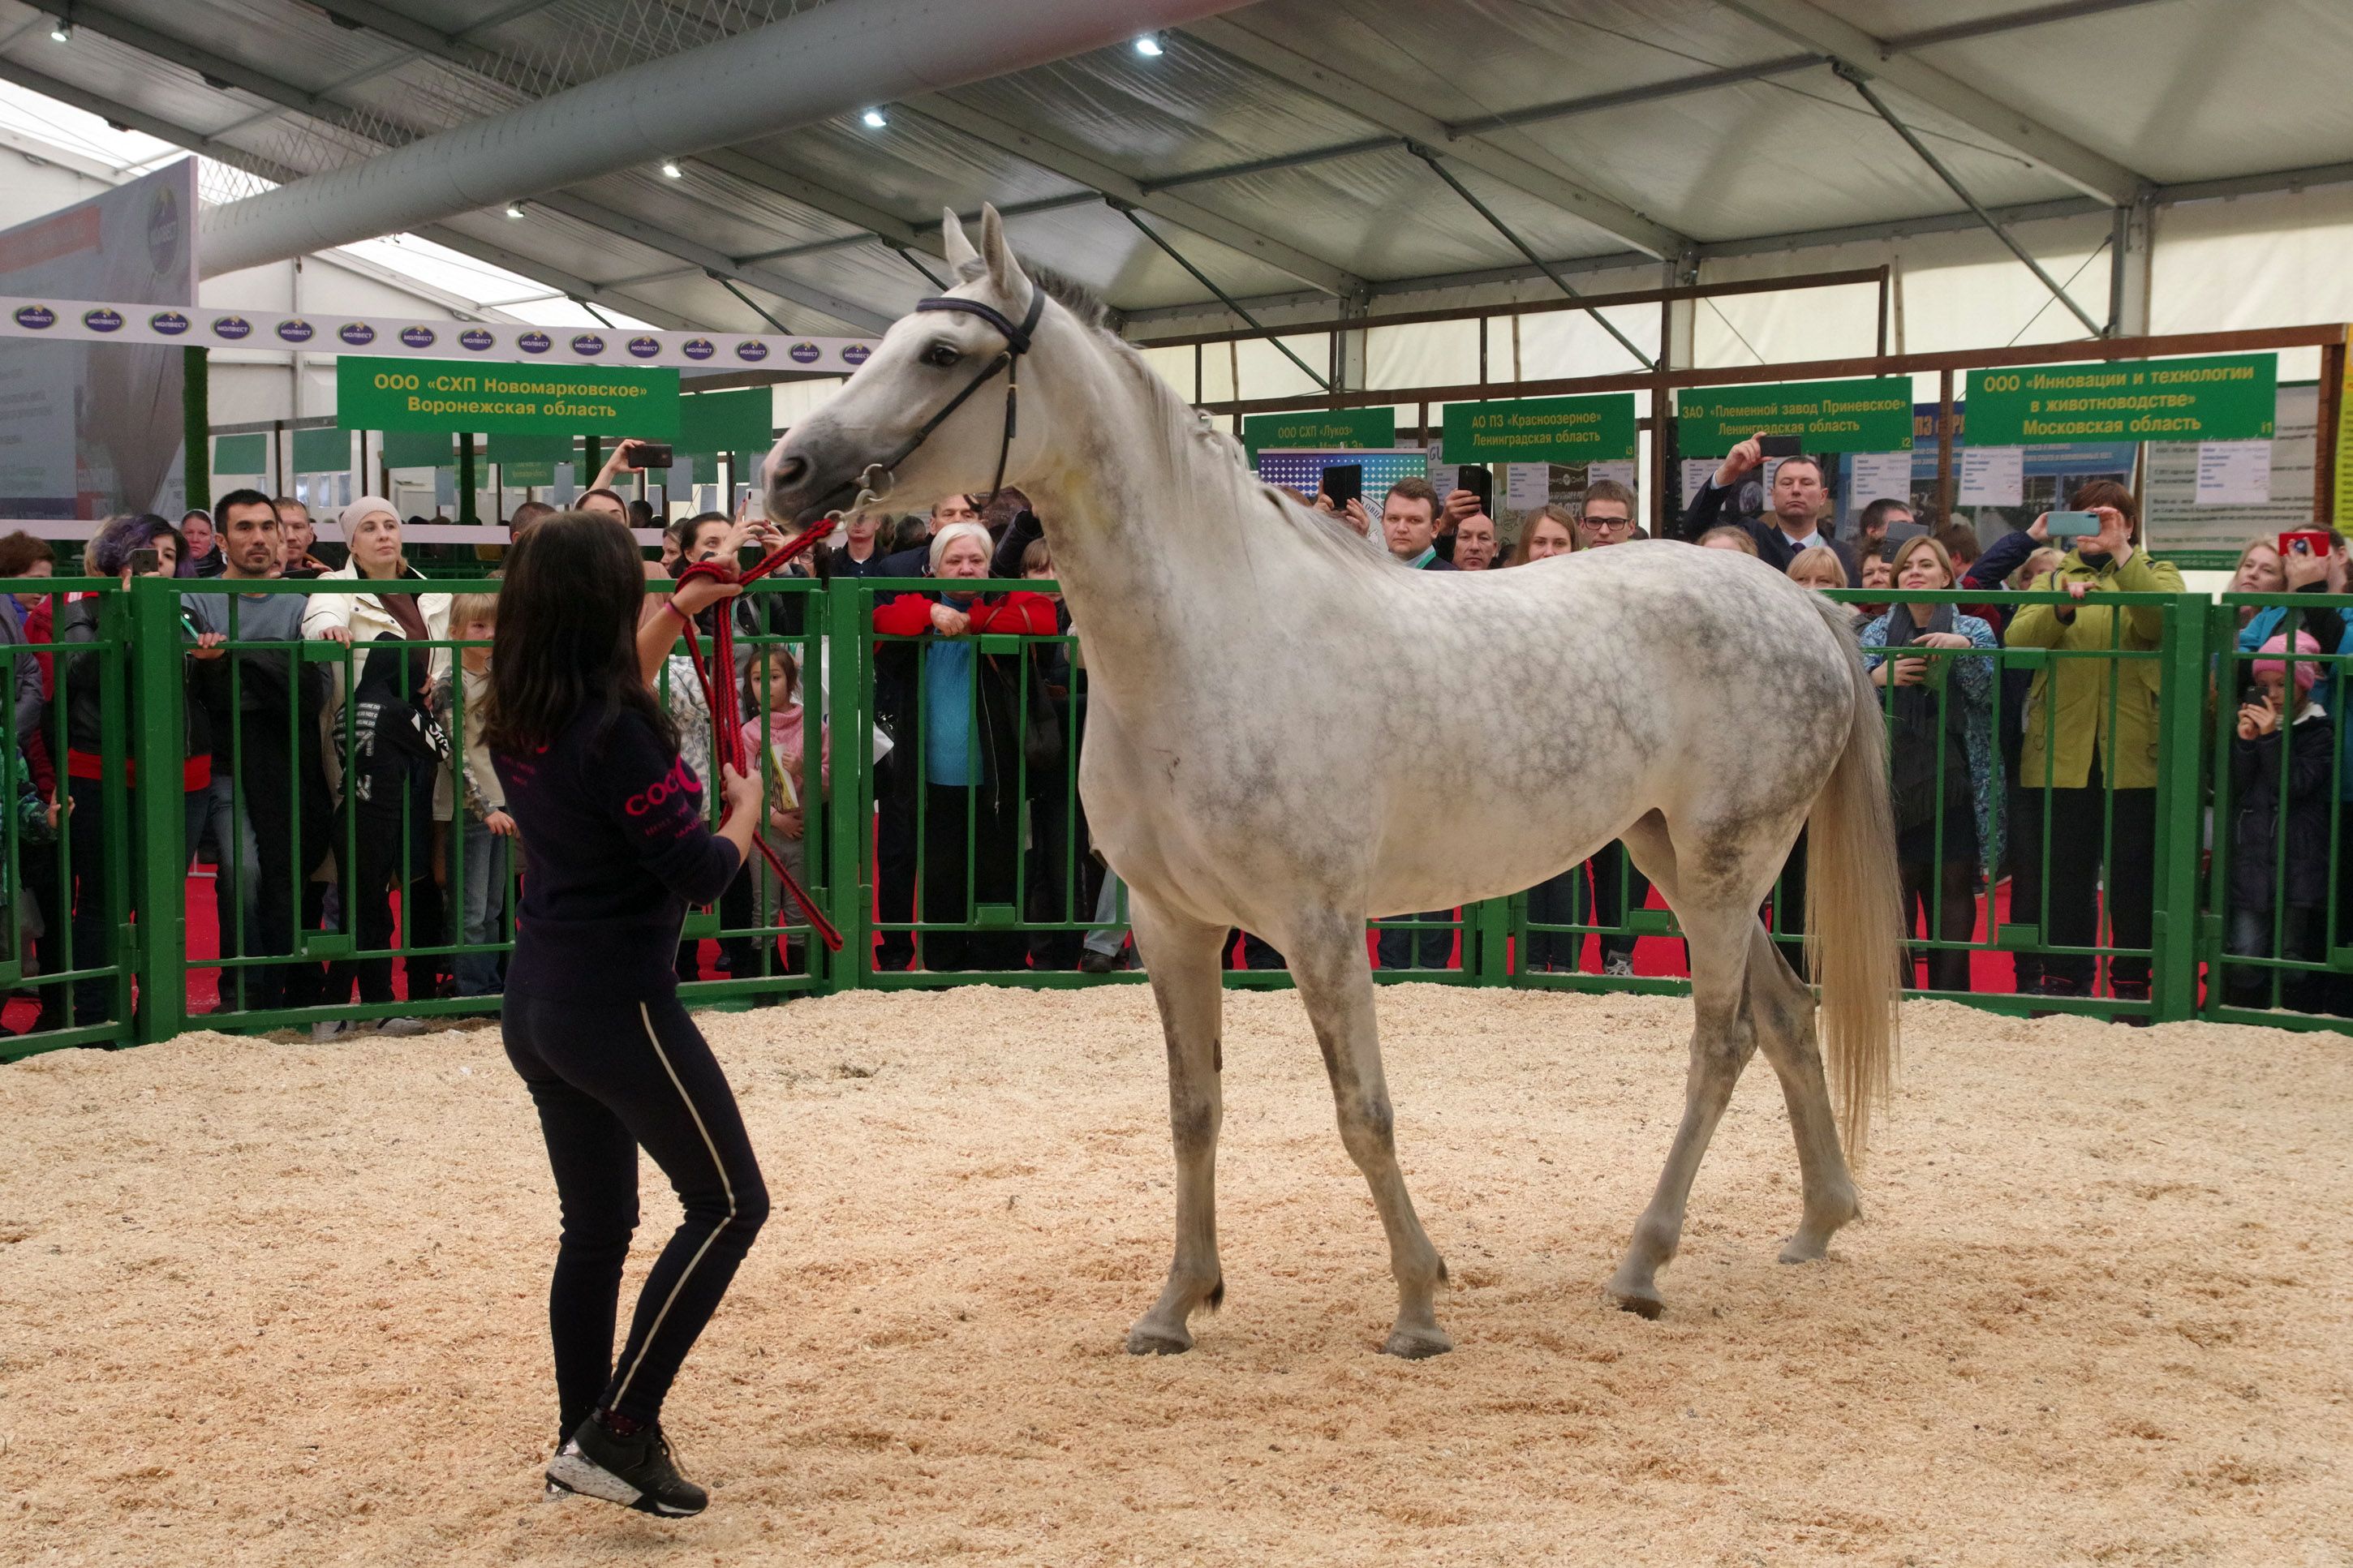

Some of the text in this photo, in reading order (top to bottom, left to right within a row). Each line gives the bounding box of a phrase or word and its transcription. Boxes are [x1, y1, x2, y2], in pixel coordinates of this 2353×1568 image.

[374, 374, 647, 398] ООО «СХП Новомарковское»
[1984, 367, 2255, 392] ООО «Инновации и технологии
[408, 397, 617, 417] Воронежская область
[1682, 398, 1906, 419] ЗАО «Племенной завод Приневское»
[2031, 393, 2196, 413] в животноводстве»
[1472, 412, 1602, 428] АО ПЗ «Красноозерное»
[1719, 419, 1860, 436] Ленинградская область
[2024, 415, 2202, 436] Московская область
[1279, 424, 1353, 440] ООО СХП «Лукоз»
[1473, 429, 1601, 448] Ленинградская область
